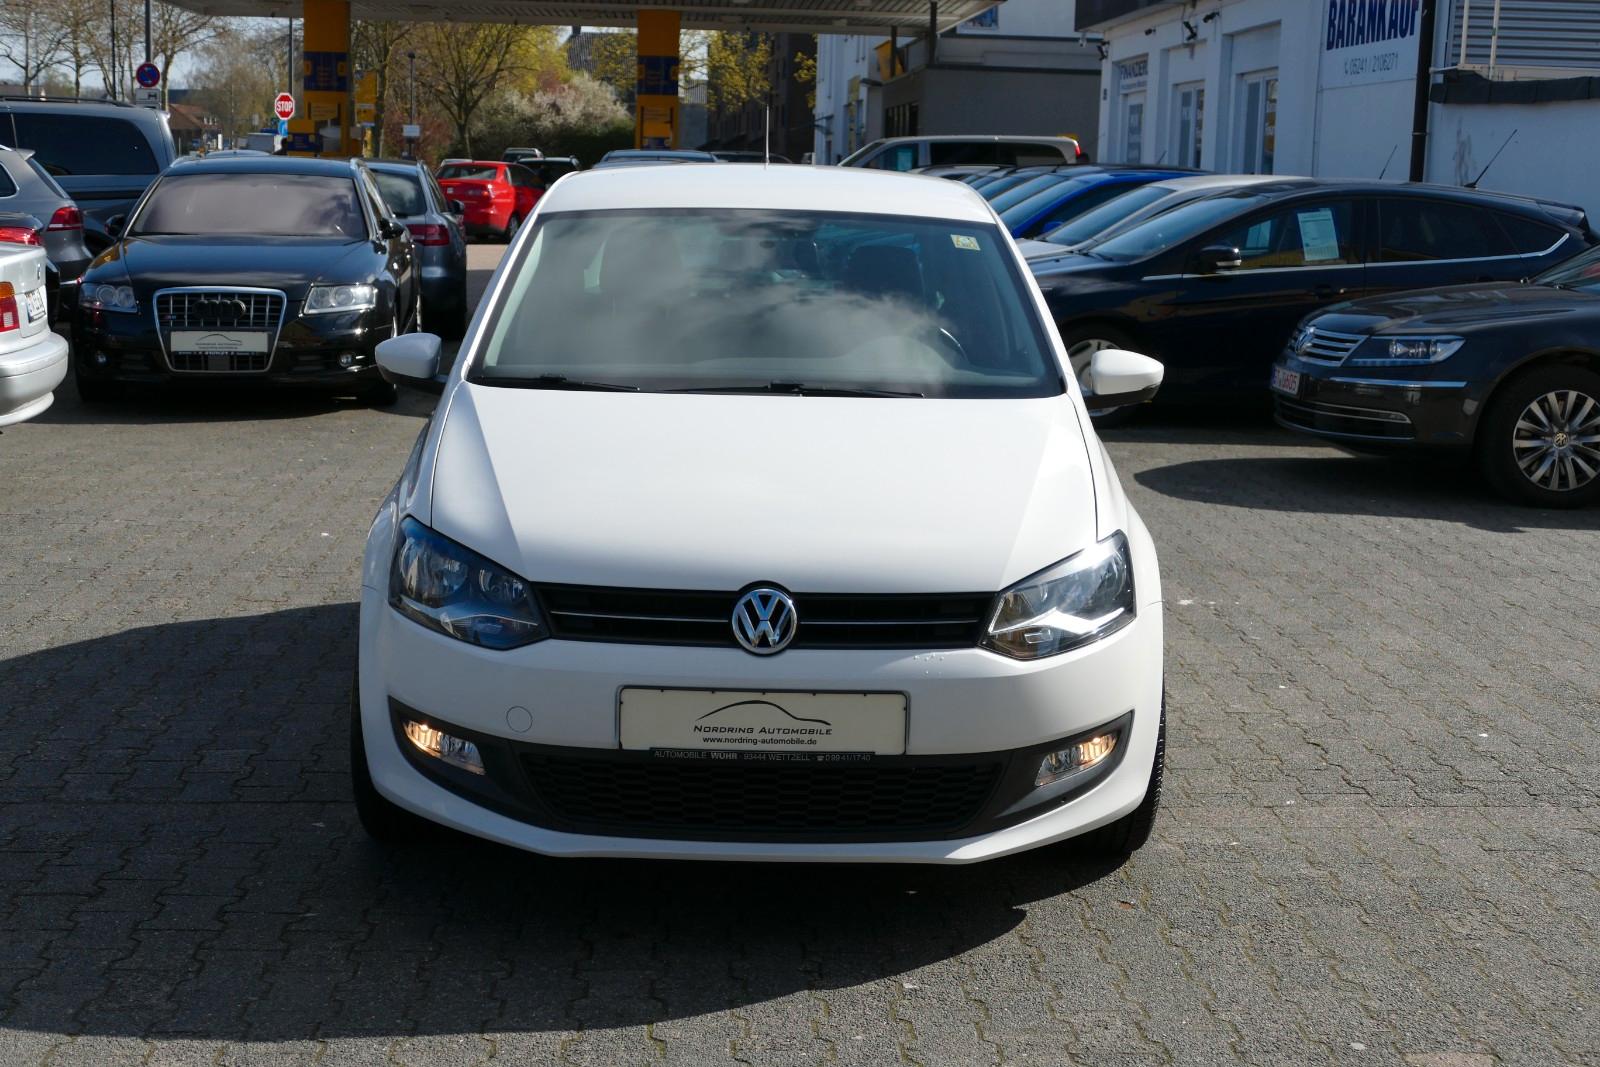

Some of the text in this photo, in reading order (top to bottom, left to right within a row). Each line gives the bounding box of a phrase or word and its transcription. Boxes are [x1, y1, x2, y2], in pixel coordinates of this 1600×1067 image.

[1326, 0, 1419, 51] BARANKAUF
[276, 101, 293, 112] STOP
[702, 736, 817, 746] www.nordring-automobile.de
[654, 751, 707, 759] AUTOMOBILE
